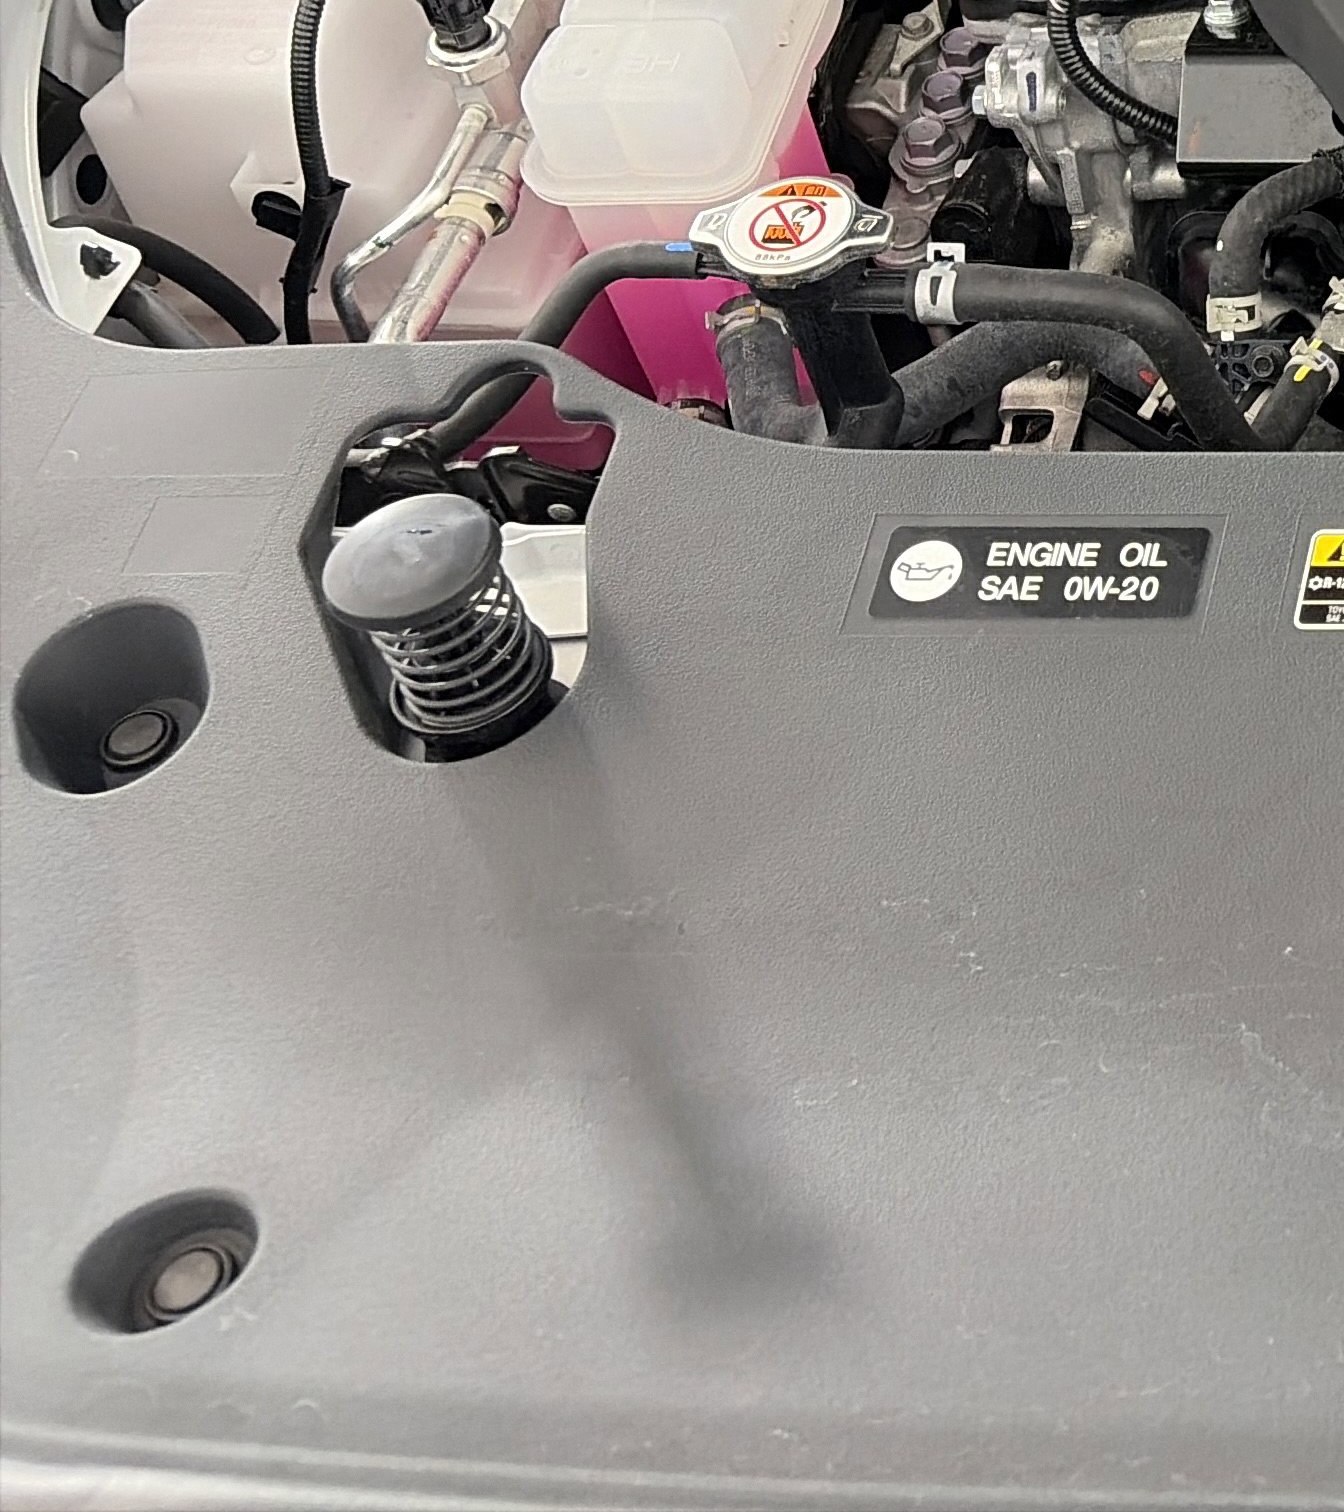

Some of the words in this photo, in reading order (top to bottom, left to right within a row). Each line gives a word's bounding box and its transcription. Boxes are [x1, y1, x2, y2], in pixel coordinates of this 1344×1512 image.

[986, 541, 1101, 567] ENGINE
[1119, 541, 1168, 567] OIL
[977, 575, 1043, 601] SAE
[1063, 575, 1160, 601] 0W-20
